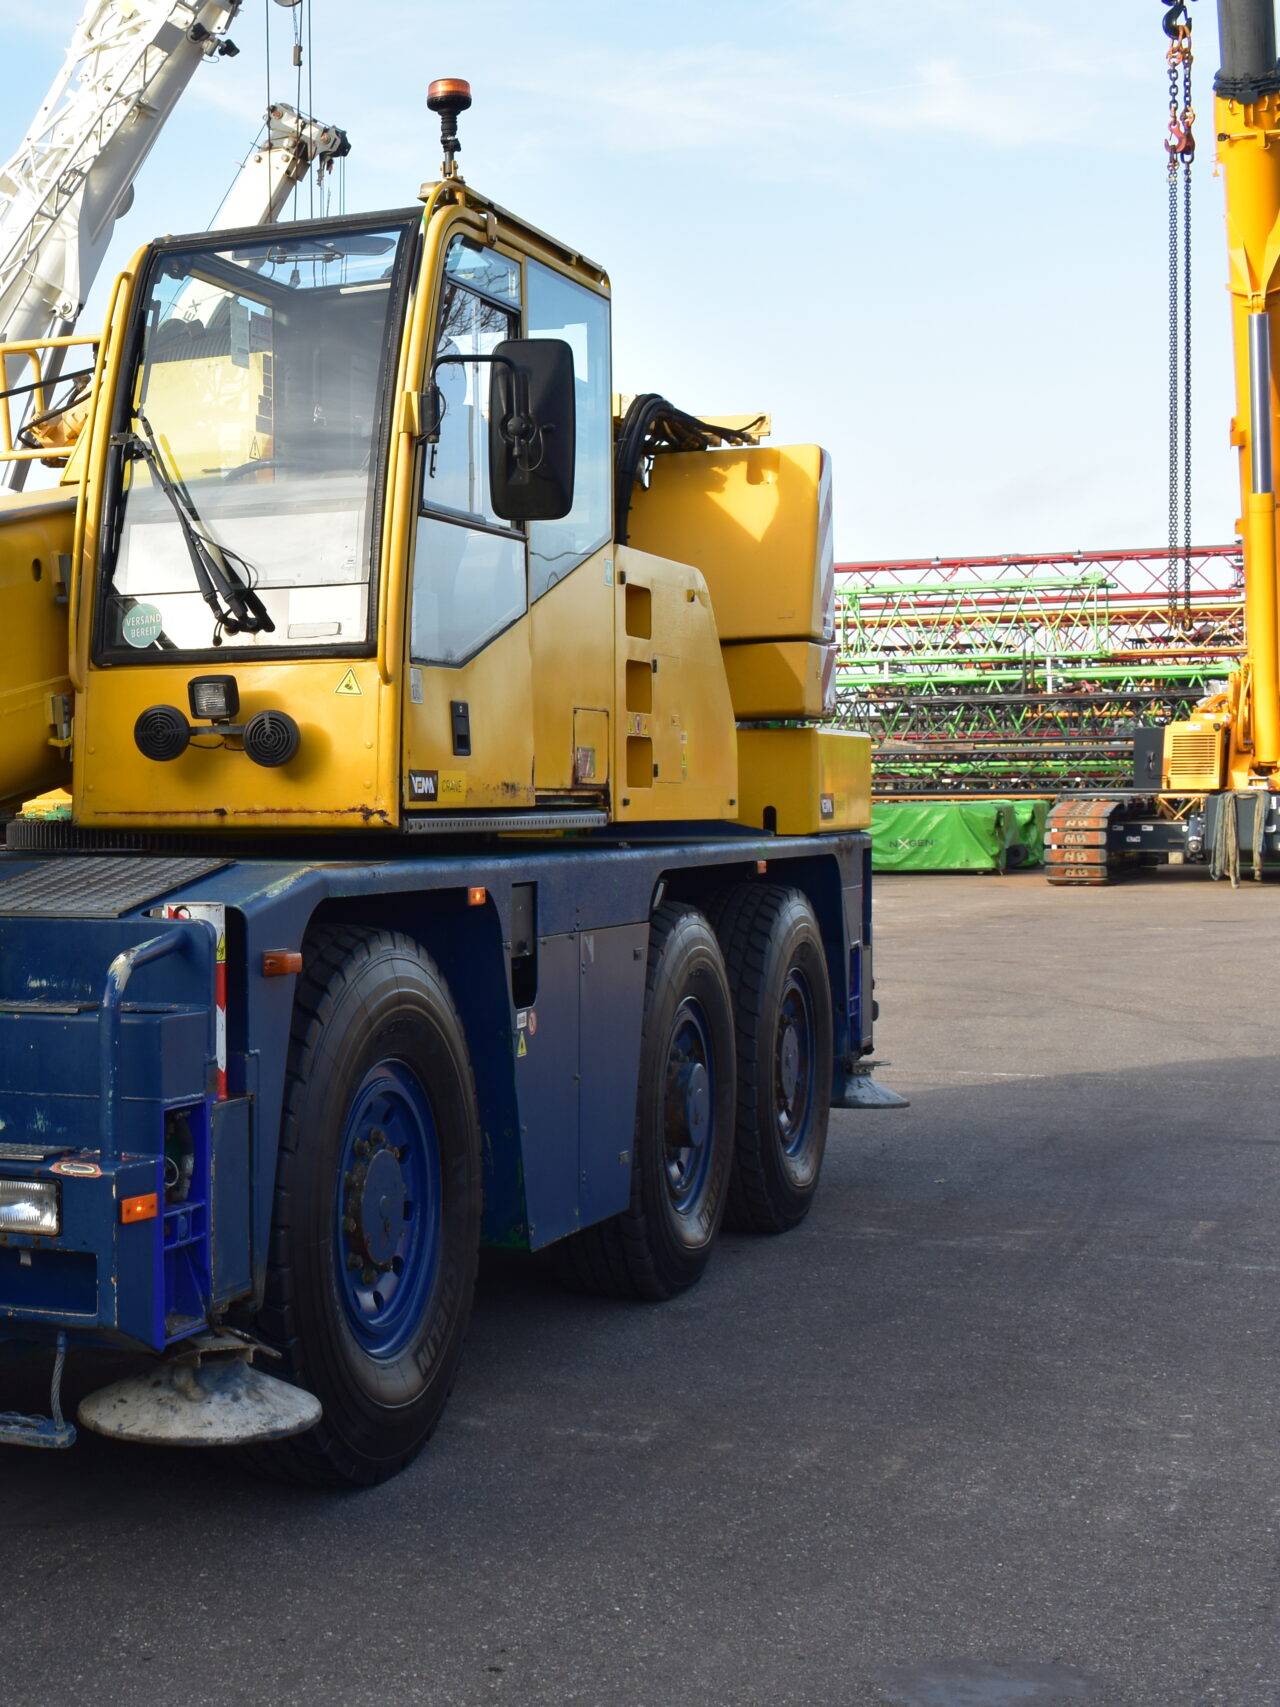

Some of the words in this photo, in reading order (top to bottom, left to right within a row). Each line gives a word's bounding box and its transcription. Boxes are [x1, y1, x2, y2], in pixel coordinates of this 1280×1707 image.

[126, 613, 161, 627] VERSAND
[131, 625, 156, 639] BEREIT
[409, 772, 436, 794] VEMA
[441, 778, 463, 793] CRANE
